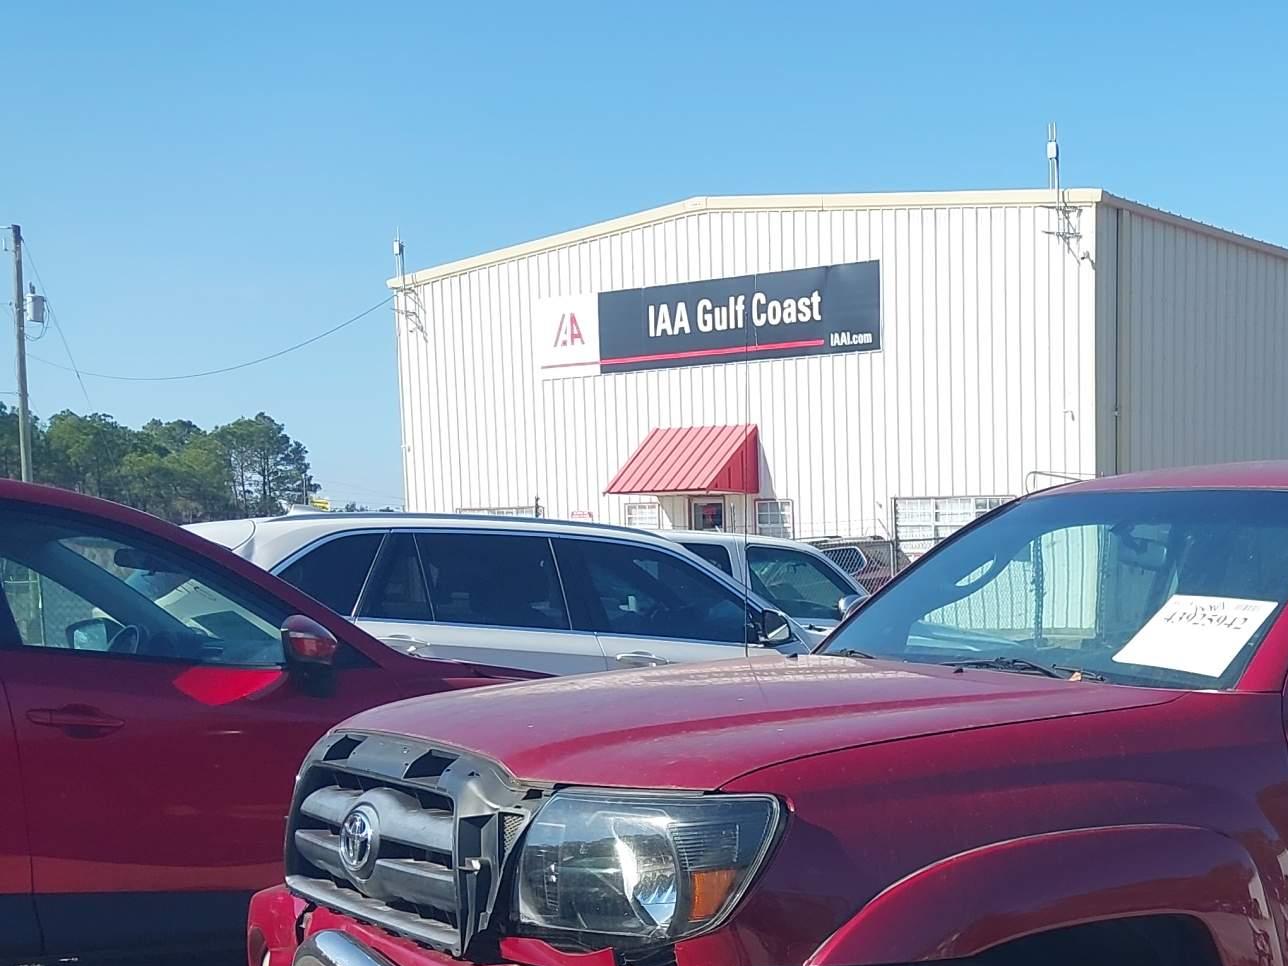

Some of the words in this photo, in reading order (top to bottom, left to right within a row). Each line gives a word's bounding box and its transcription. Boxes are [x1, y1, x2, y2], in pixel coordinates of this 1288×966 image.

[648, 302, 691, 337] IAA
[697, 295, 745, 332] Gulf
[751, 291, 822, 327] Coast
